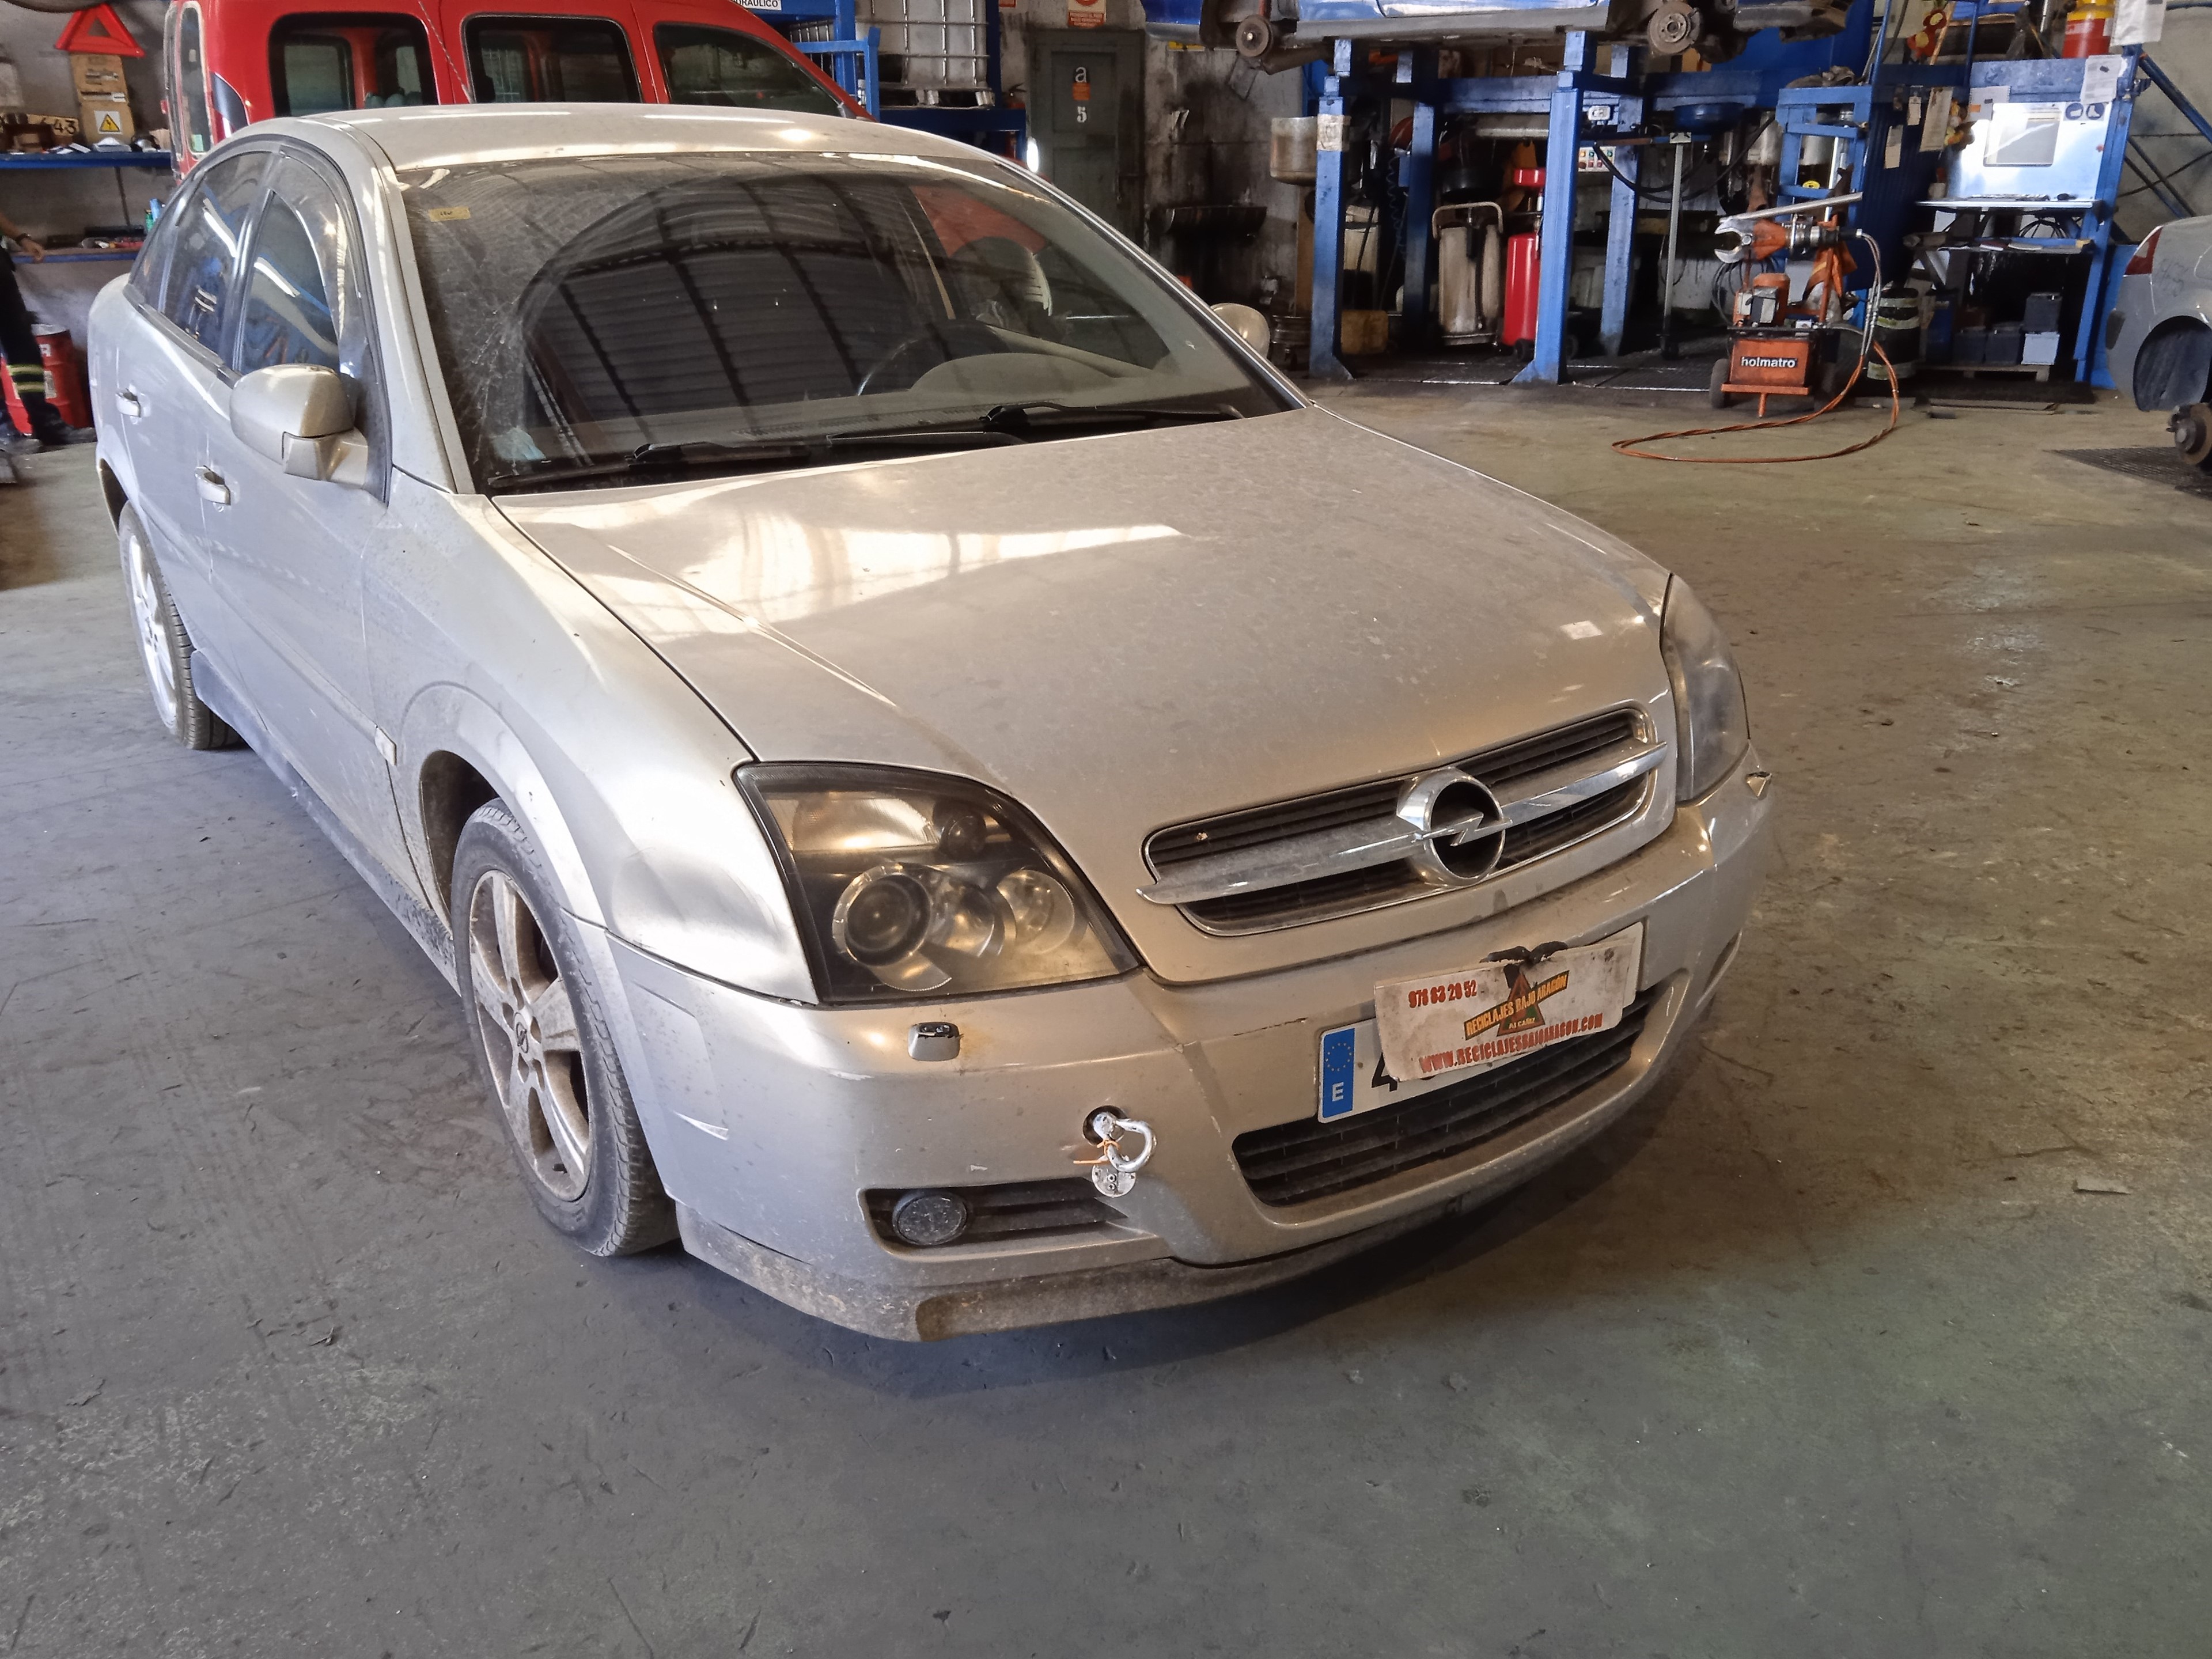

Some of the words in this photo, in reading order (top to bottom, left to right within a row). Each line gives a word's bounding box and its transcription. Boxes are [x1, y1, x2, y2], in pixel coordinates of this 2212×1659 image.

[1077, 106, 1088, 123] 5
[1741, 357, 1796, 368] holmatro
[1464, 979, 1477, 998] 52
[1465, 1001, 1514, 1036] RECICLAJES
[1515, 990, 1536, 1013] BAJO
[1332, 1081, 1344, 1102] E
